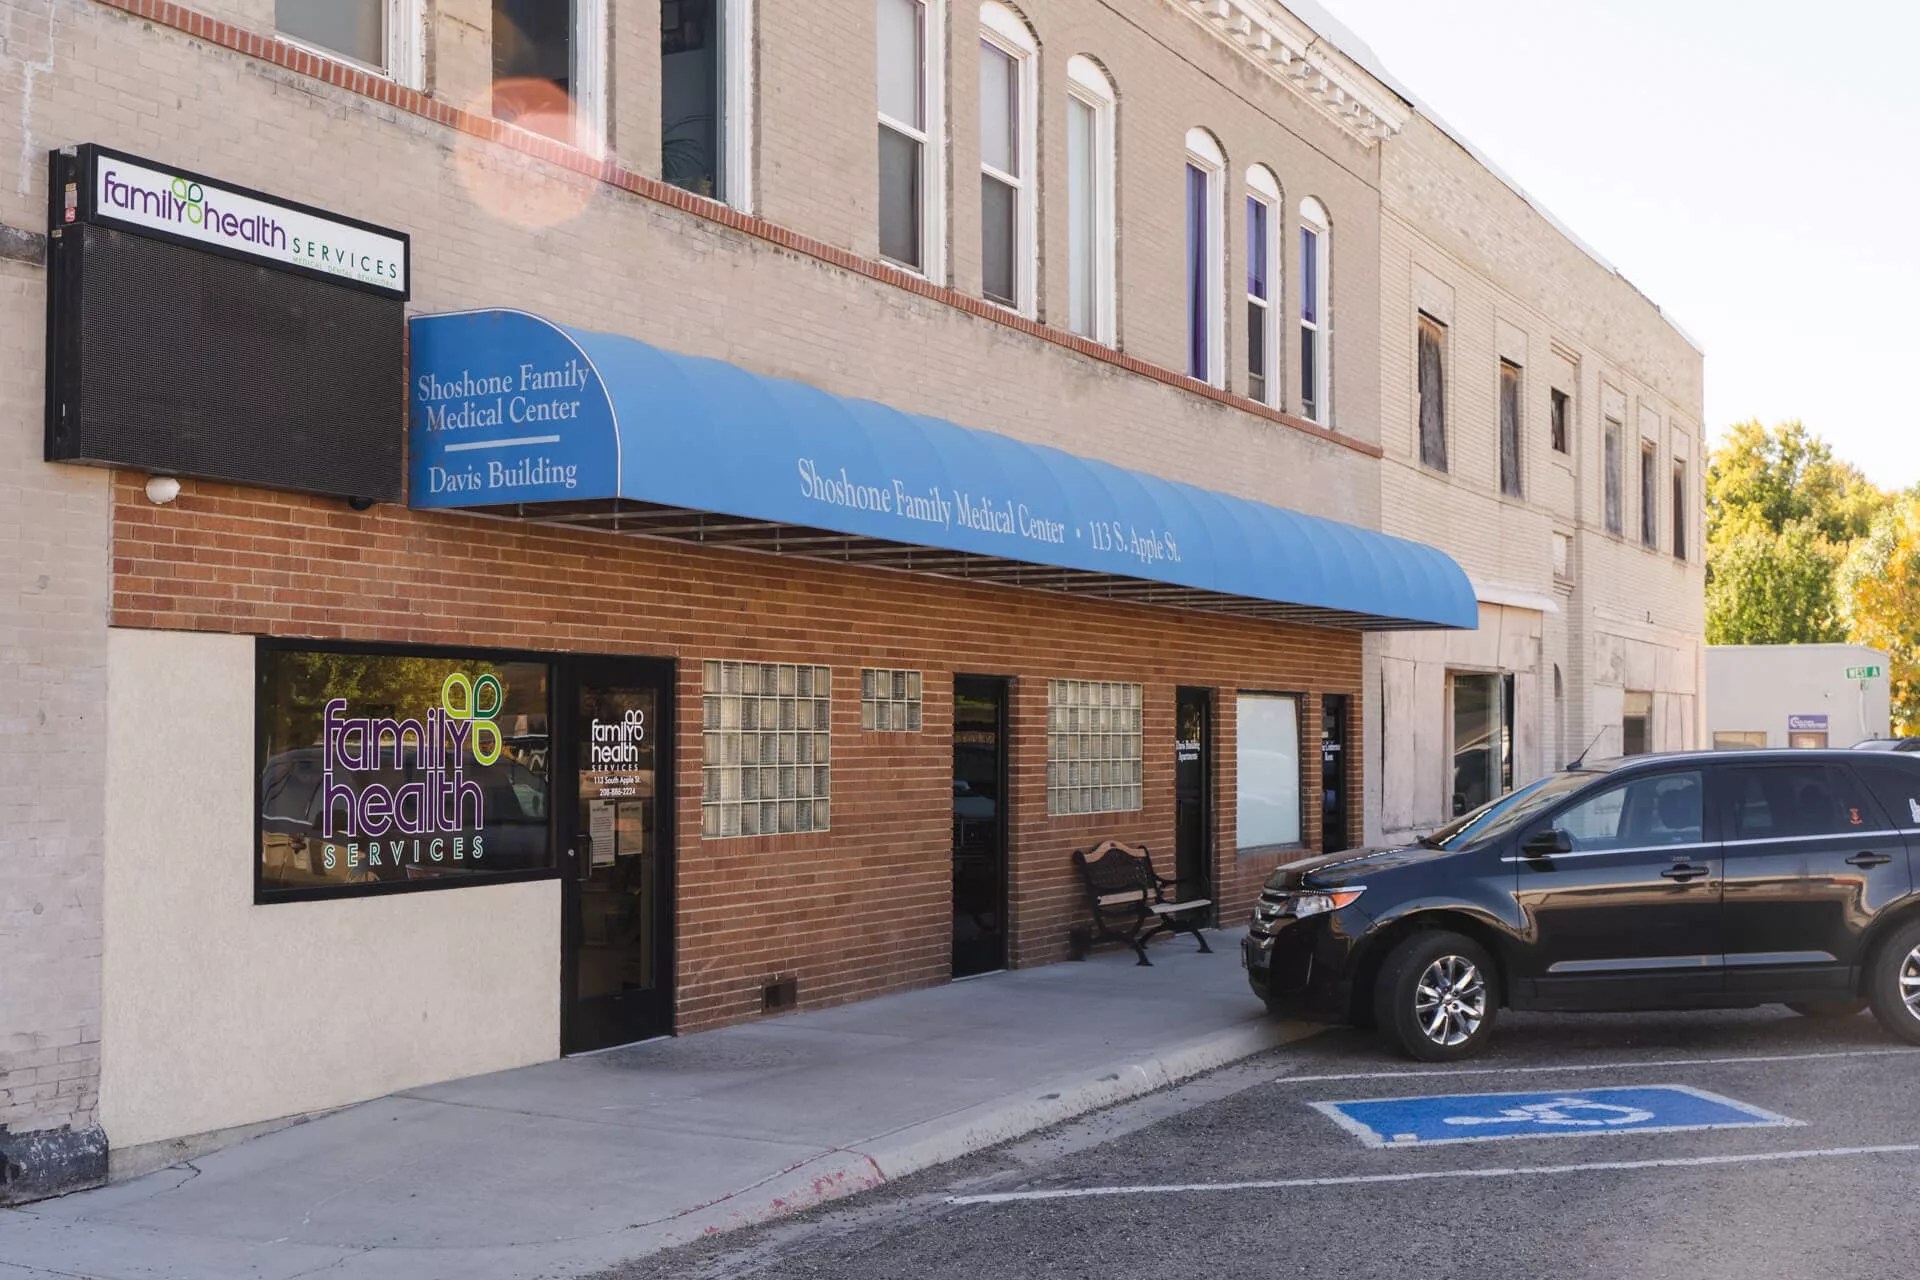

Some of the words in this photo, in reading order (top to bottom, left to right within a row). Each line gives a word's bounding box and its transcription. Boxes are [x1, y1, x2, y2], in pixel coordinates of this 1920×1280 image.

[104, 171, 187, 223] family
[204, 201, 286, 250] health
[292, 237, 397, 279] SERVICES
[418, 370, 512, 402] Shoshone
[520, 359, 589, 392] Family
[426, 398, 503, 431] Medical
[509, 396, 580, 424] Center
[429, 465, 482, 493] Davis
[488, 457, 577, 489] Building
[798, 457, 891, 513] Shoshone
[892, 479, 950, 531] Family
[952, 490, 1016, 535] Medical
[1018, 503, 1065, 544] Center
[1089, 520, 1112, 551] 113
[1113, 520, 1128, 552] S.
[1130, 527, 1164, 565] Apple
[1164, 531, 1182, 562] St.
[323, 697, 472, 771] family
[592, 719, 634, 741] family
[592, 742, 638, 763] health
[592, 764, 638, 773] SERVICES
[594, 776, 604, 784] 113
[605, 776, 619, 784] South
[620, 776, 634, 786] Apple
[323, 770, 483, 838] health
[323, 836, 484, 869] SERVICES
